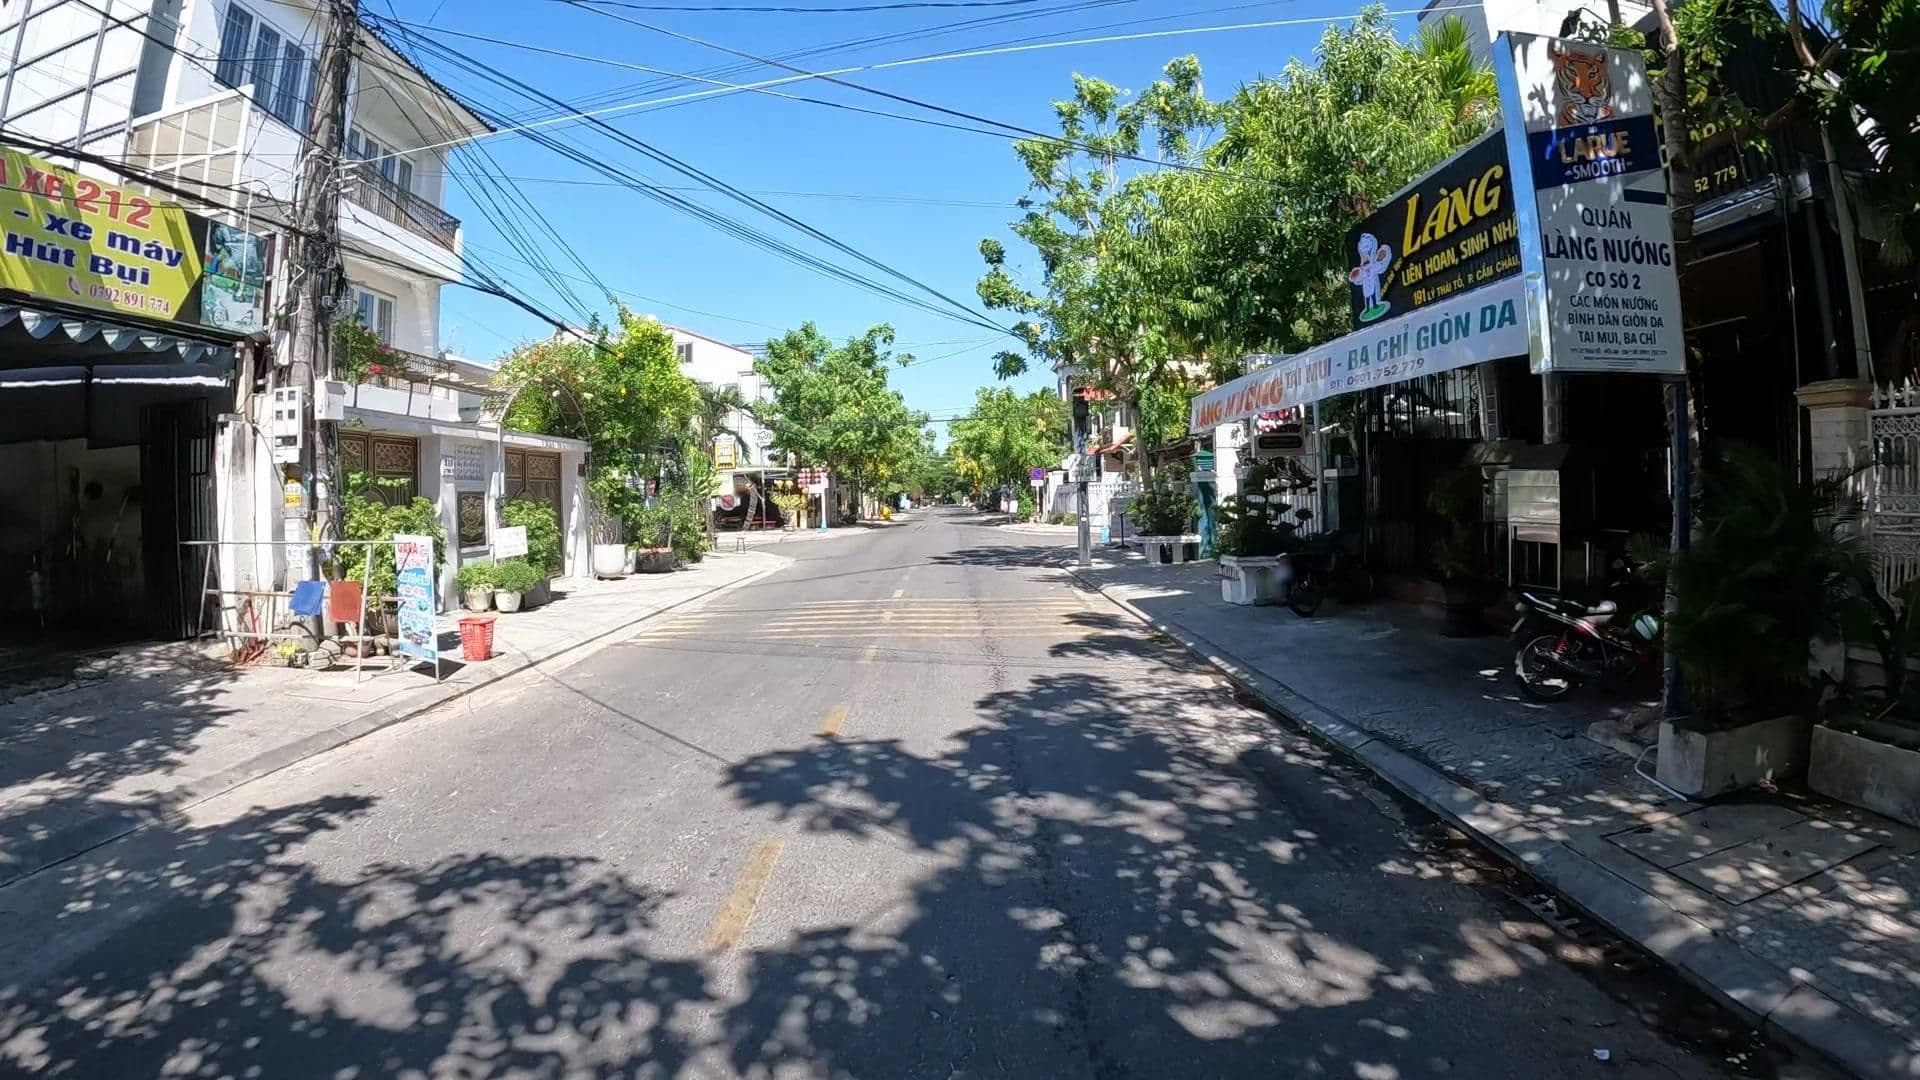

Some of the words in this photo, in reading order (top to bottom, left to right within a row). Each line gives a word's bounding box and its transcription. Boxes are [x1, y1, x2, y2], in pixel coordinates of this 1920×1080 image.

[1560, 131, 1631, 164] LARUE
[1714, 165, 1737, 185] 779
[20, 167, 64, 203] XE
[73, 180, 152, 229] 212
[1402, 165, 1503, 258] LÀNG
[1581, 205, 1632, 230] QUÁN
[45, 213, 93, 241] xe
[107, 230, 183, 267] máy
[1544, 228, 1598, 262] LÀNG
[1602, 235, 1671, 267] NƯỚNG
[6, 232, 76, 268] Hút
[90, 254, 150, 285] Bụi
[1401, 262, 1423, 287] LIÊN
[1425, 247, 1459, 276] HOAN,
[1461, 230, 1489, 260] SINH
[1413, 288, 1427, 306] 191
[1631, 273, 1641, 290] 2
[124, 291, 144, 308] 891
[1348, 345, 1370, 371] BA
[1376, 324, 1408, 363] CHỈ
[1416, 312, 1470, 351] GIÒN
[1480, 299, 1517, 333] DA
[1578, 330, 1594, 343] TAI
[1624, 332, 1638, 345] BA
[1650, 316, 1664, 328] DA
